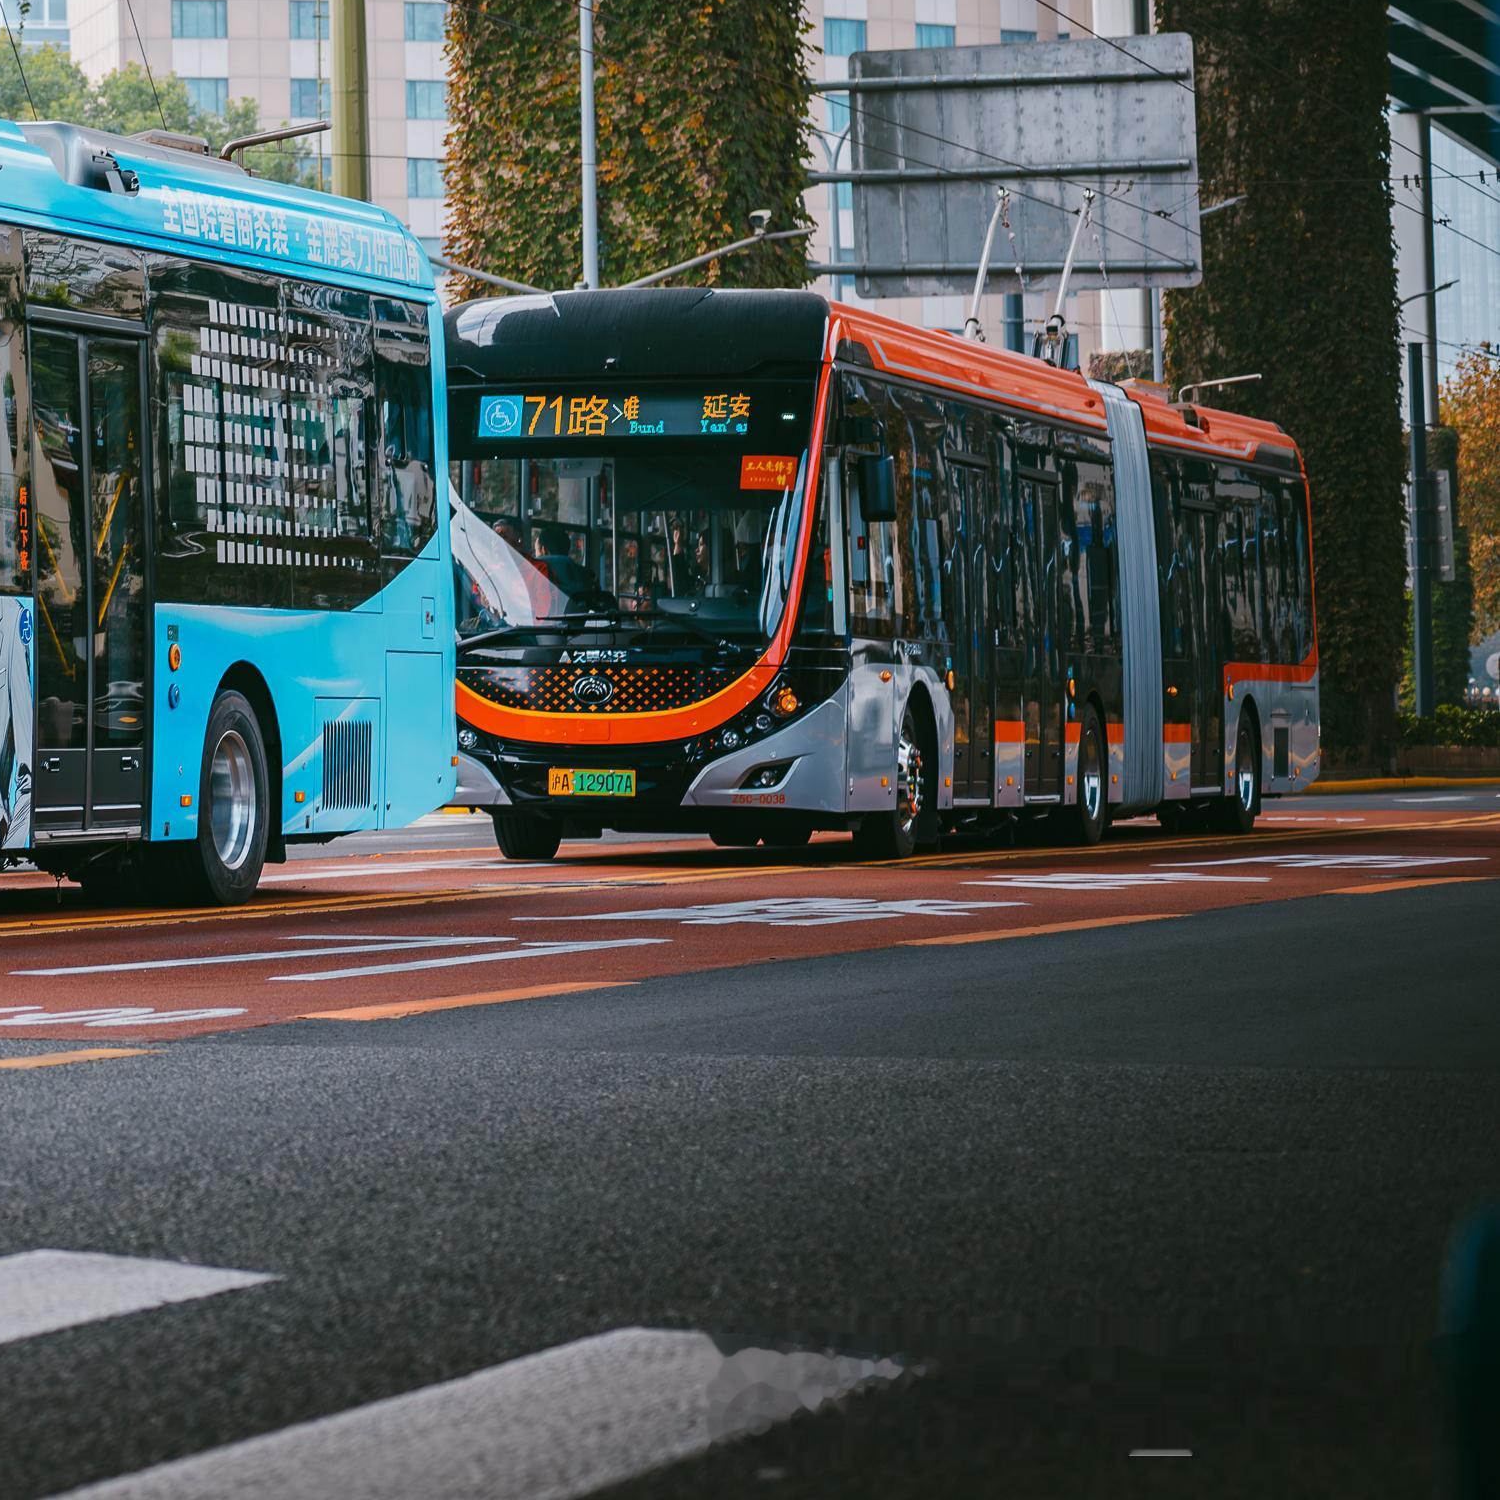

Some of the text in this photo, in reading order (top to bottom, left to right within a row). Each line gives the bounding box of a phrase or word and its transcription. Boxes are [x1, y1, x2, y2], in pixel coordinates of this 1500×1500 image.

[524, 394, 609, 437] 71路
[702, 393, 752, 420] 延安
[629, 420, 665, 434] Bund
